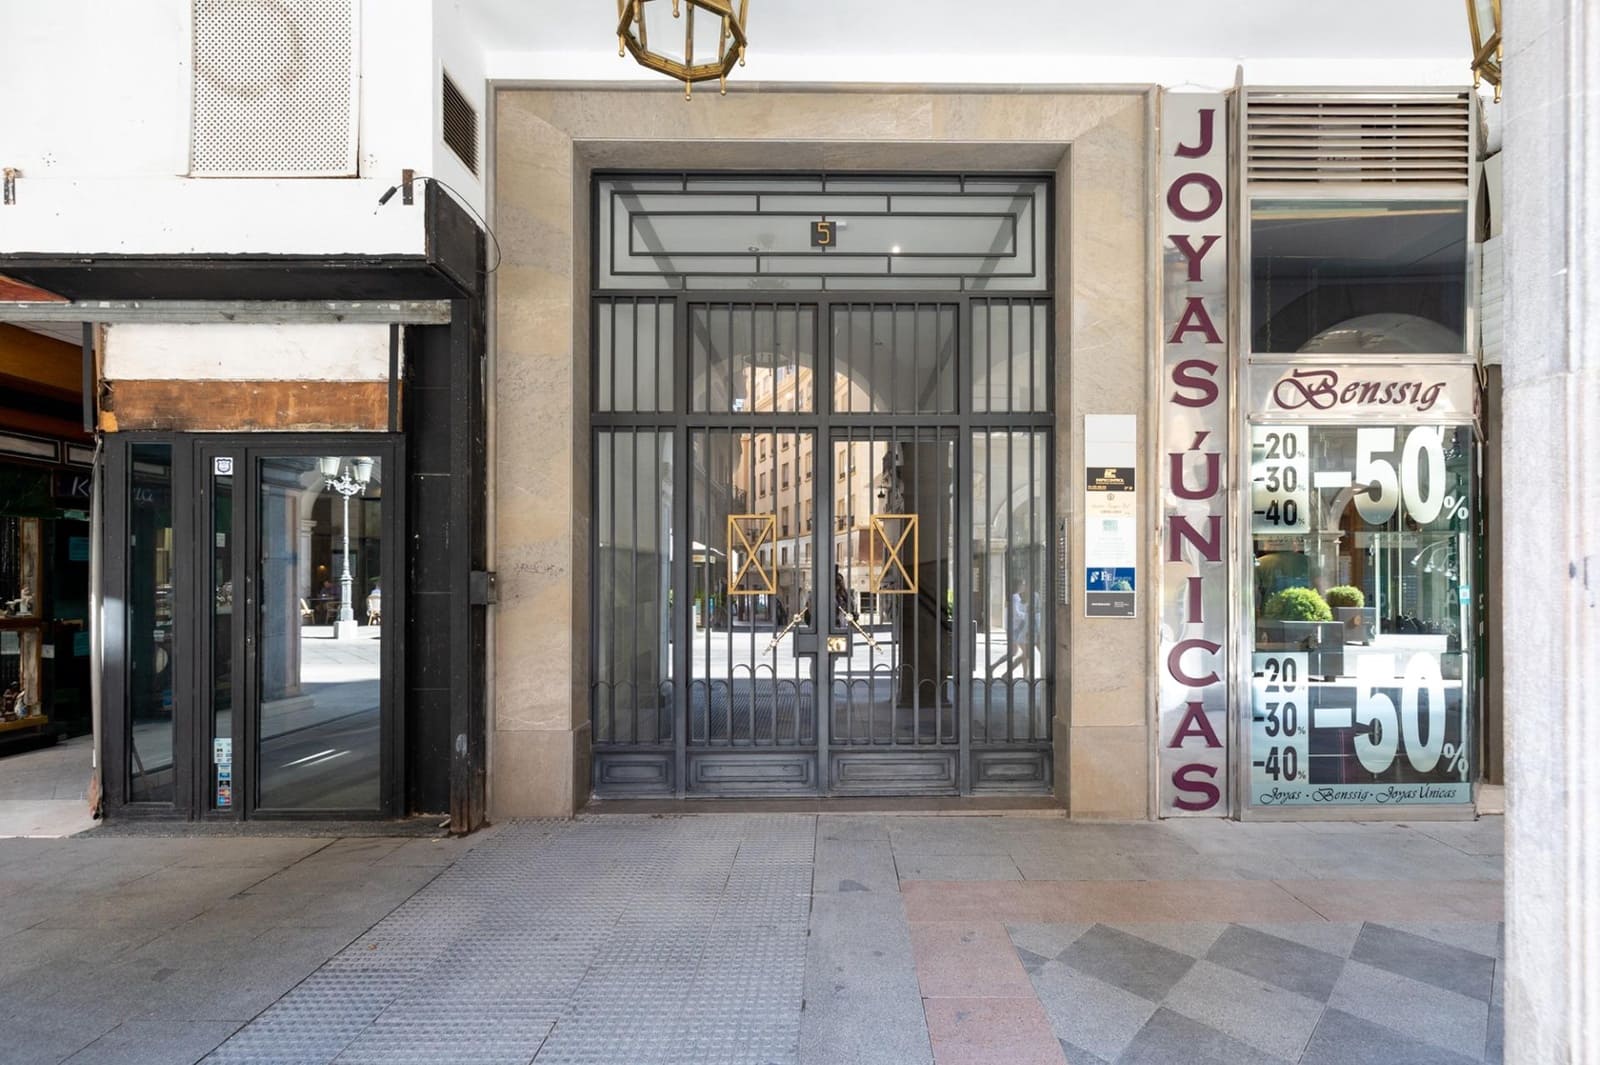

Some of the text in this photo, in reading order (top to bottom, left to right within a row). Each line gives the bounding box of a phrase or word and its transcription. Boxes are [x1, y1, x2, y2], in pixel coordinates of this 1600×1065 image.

[817, 222, 831, 245] 5
[1273, 368, 1446, 412] Benssig
[1167, 109, 1224, 811] JOYAS ÚNICAS
[1260, 787, 1302, 805] Joyas
[1312, 787, 1369, 804] Benssig
[1375, 786, 1418, 805] Joyas
